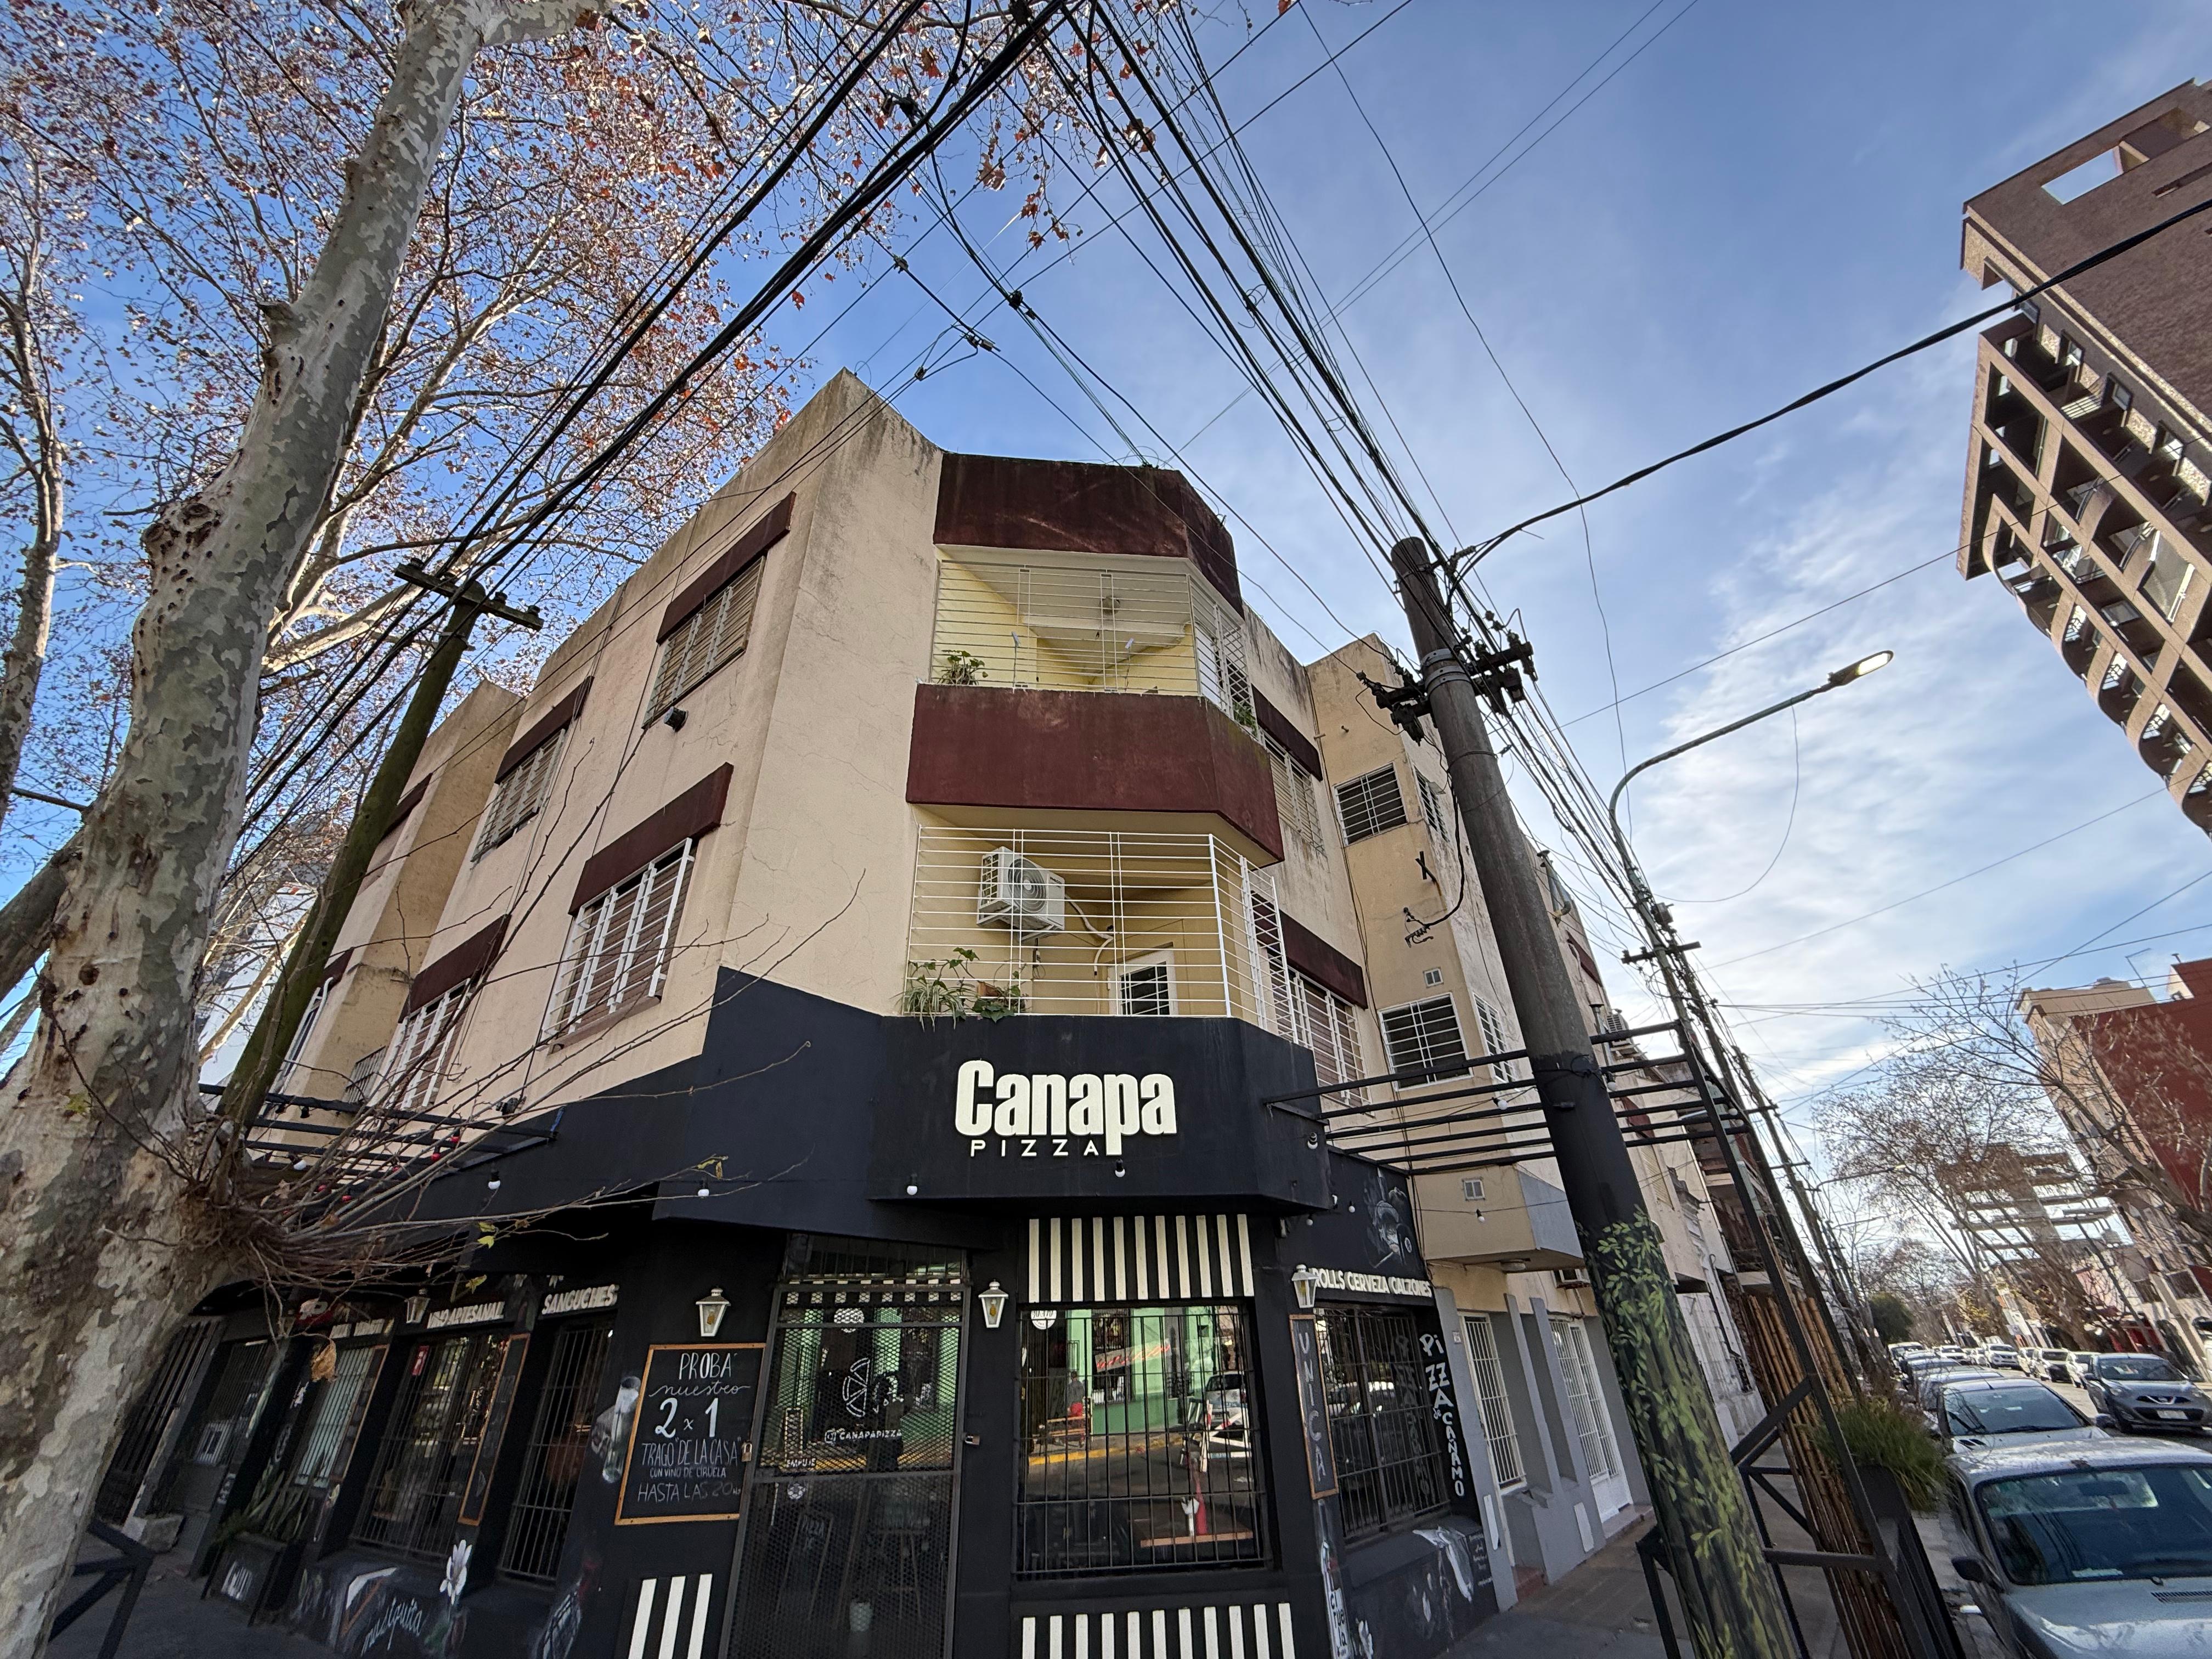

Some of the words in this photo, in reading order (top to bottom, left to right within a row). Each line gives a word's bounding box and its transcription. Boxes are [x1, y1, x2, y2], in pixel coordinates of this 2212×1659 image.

[955, 1060, 1177, 1155] Canapa
[970, 1139, 1099, 1157] PIZZA
[1345, 1272, 1390, 1294] CERVEZA
[1389, 1277, 1433, 1298] CALZONES
[542, 1284, 619, 1314] SANGUCHES
[648, 1380, 751, 1397] nuestro
[642, 1442, 674, 1467] TRAGO
[695, 1438, 707, 1465] LA
[664, 1467, 681, 1478] VINO
[684, 1468, 692, 1478] DE
[696, 1467, 726, 1479] CIRUELA
[637, 1482, 680, 1503] HASTA
[684, 1482, 708, 1502] LAS
